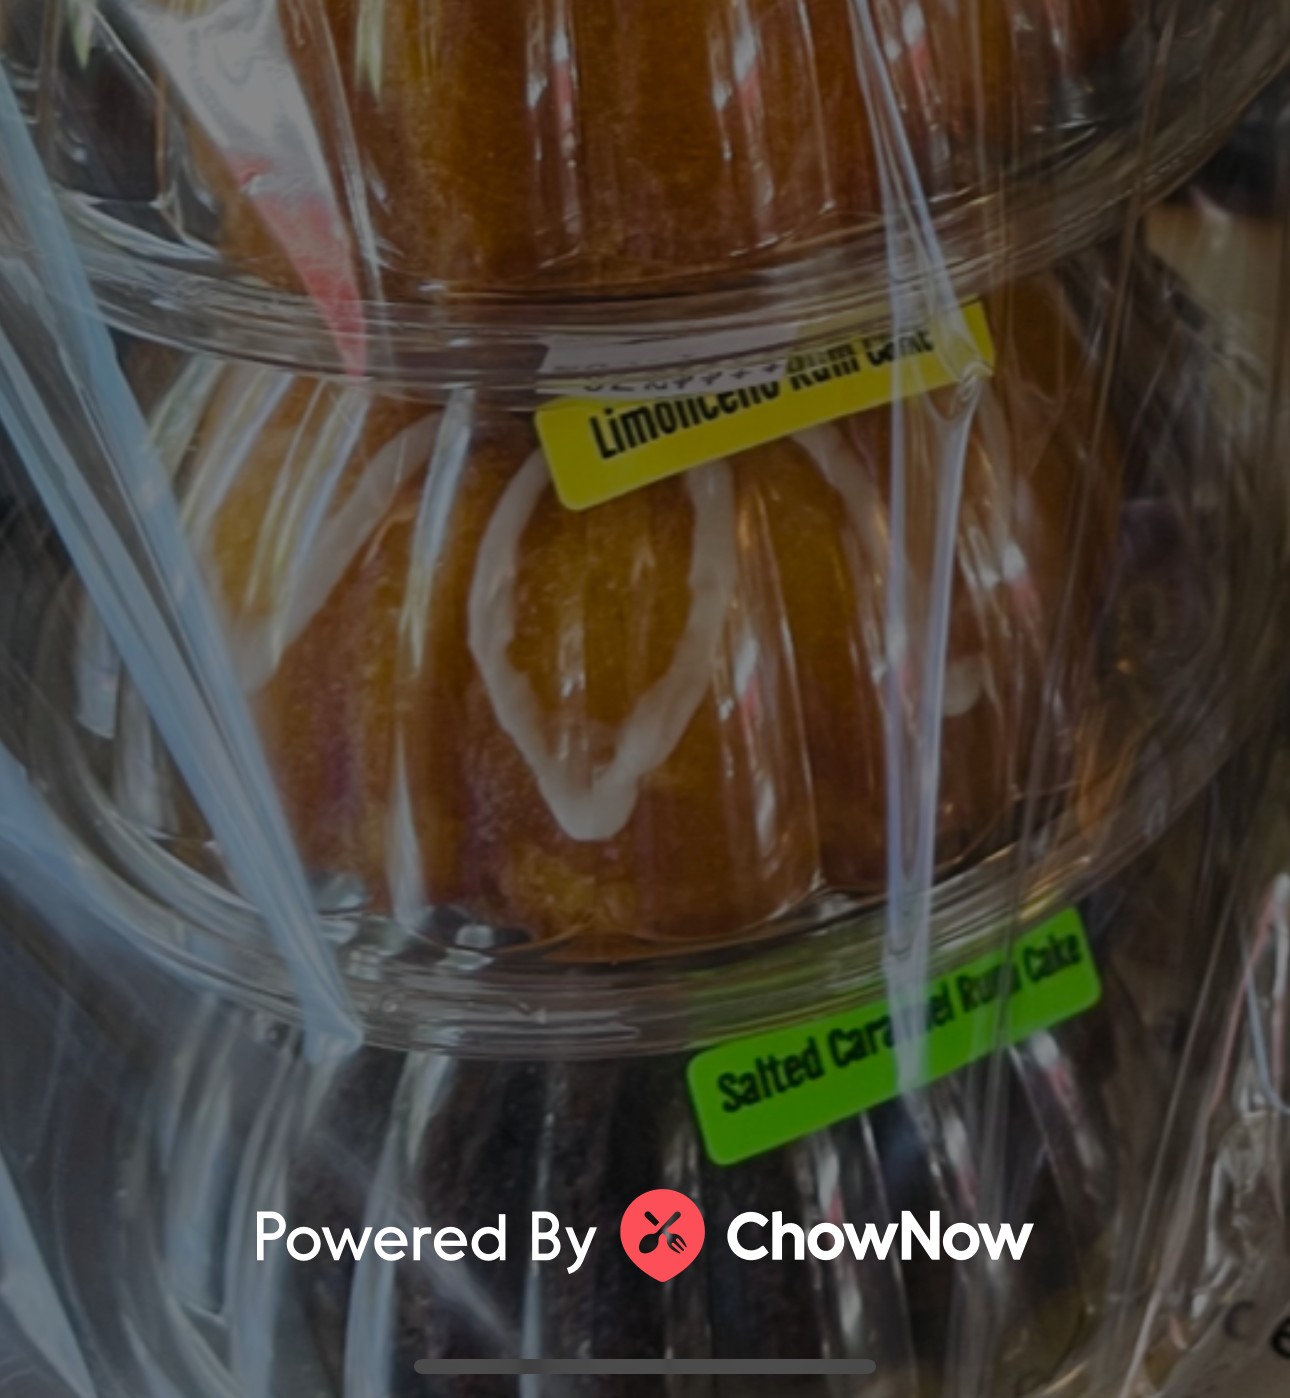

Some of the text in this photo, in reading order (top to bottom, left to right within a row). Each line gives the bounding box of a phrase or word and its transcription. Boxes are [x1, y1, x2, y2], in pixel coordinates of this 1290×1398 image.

[717, 1037, 825, 1113] Salted
[826, 981, 955, 1068] Carael
[1022, 932, 1082, 982] Cake
